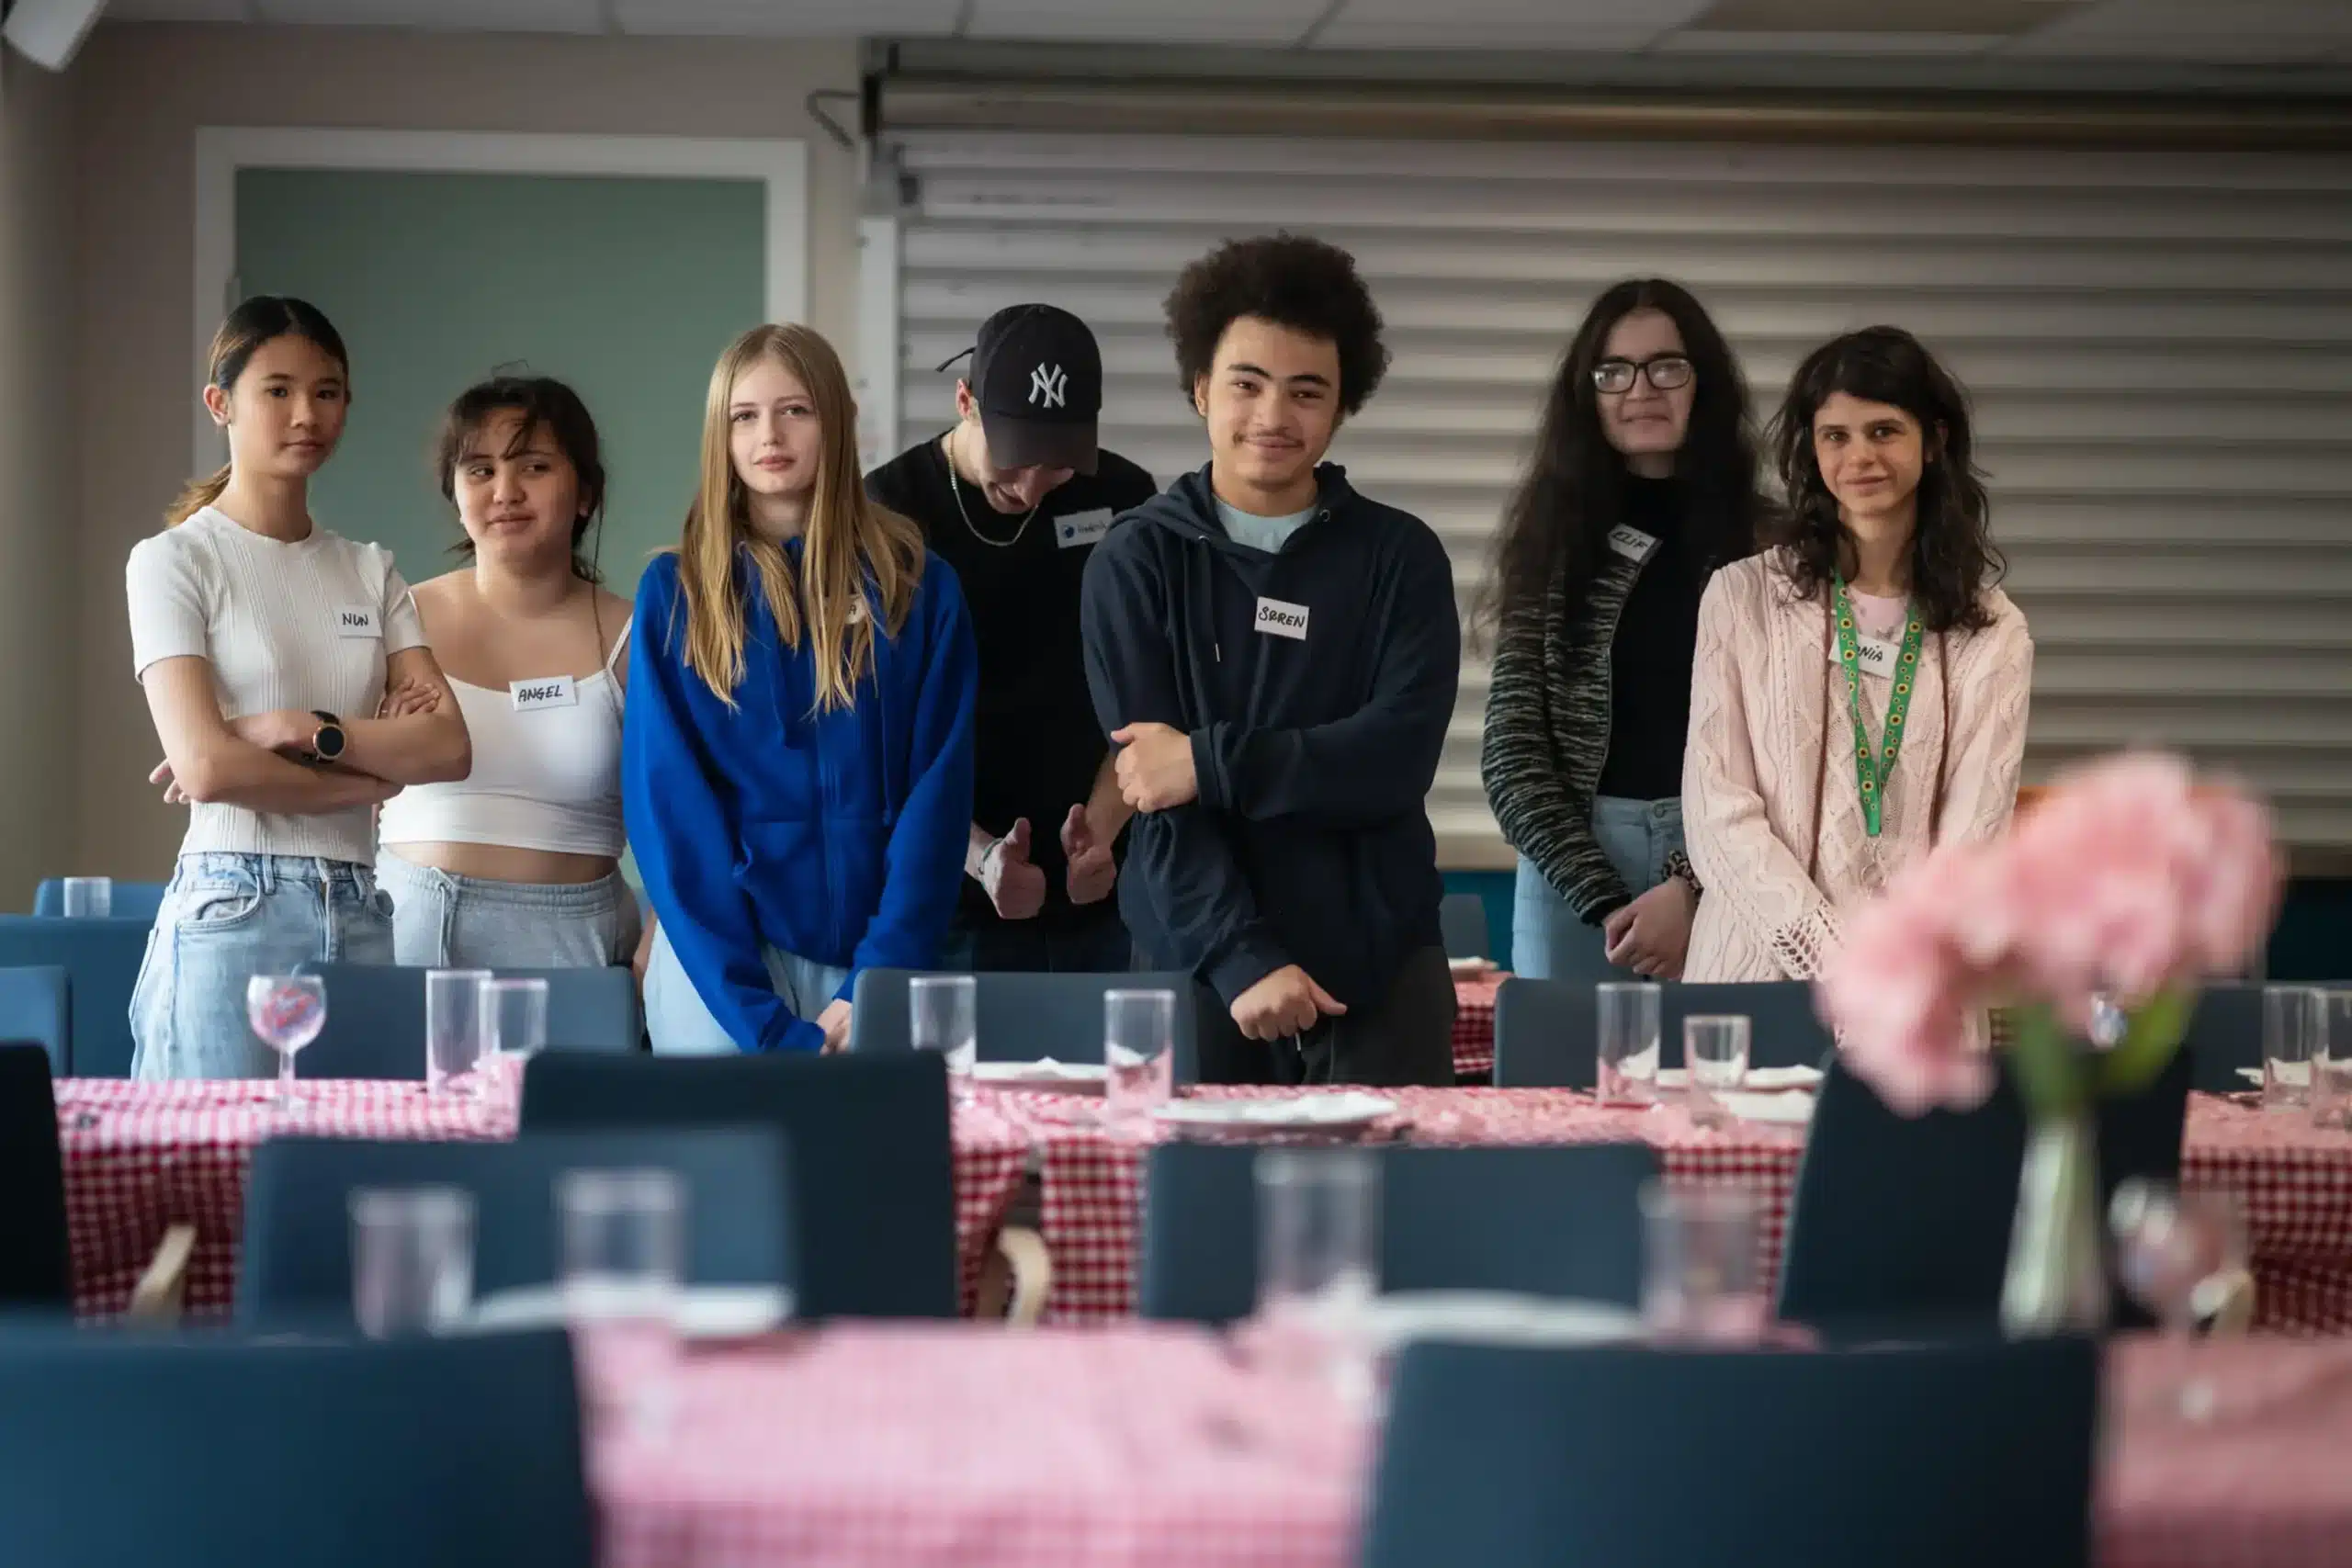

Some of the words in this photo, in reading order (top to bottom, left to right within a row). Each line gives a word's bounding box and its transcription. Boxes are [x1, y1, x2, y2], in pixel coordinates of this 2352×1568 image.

[1029, 362, 1068, 408] NY
[342, 613, 368, 626] NUN
[518, 684, 563, 702] ANGEL
